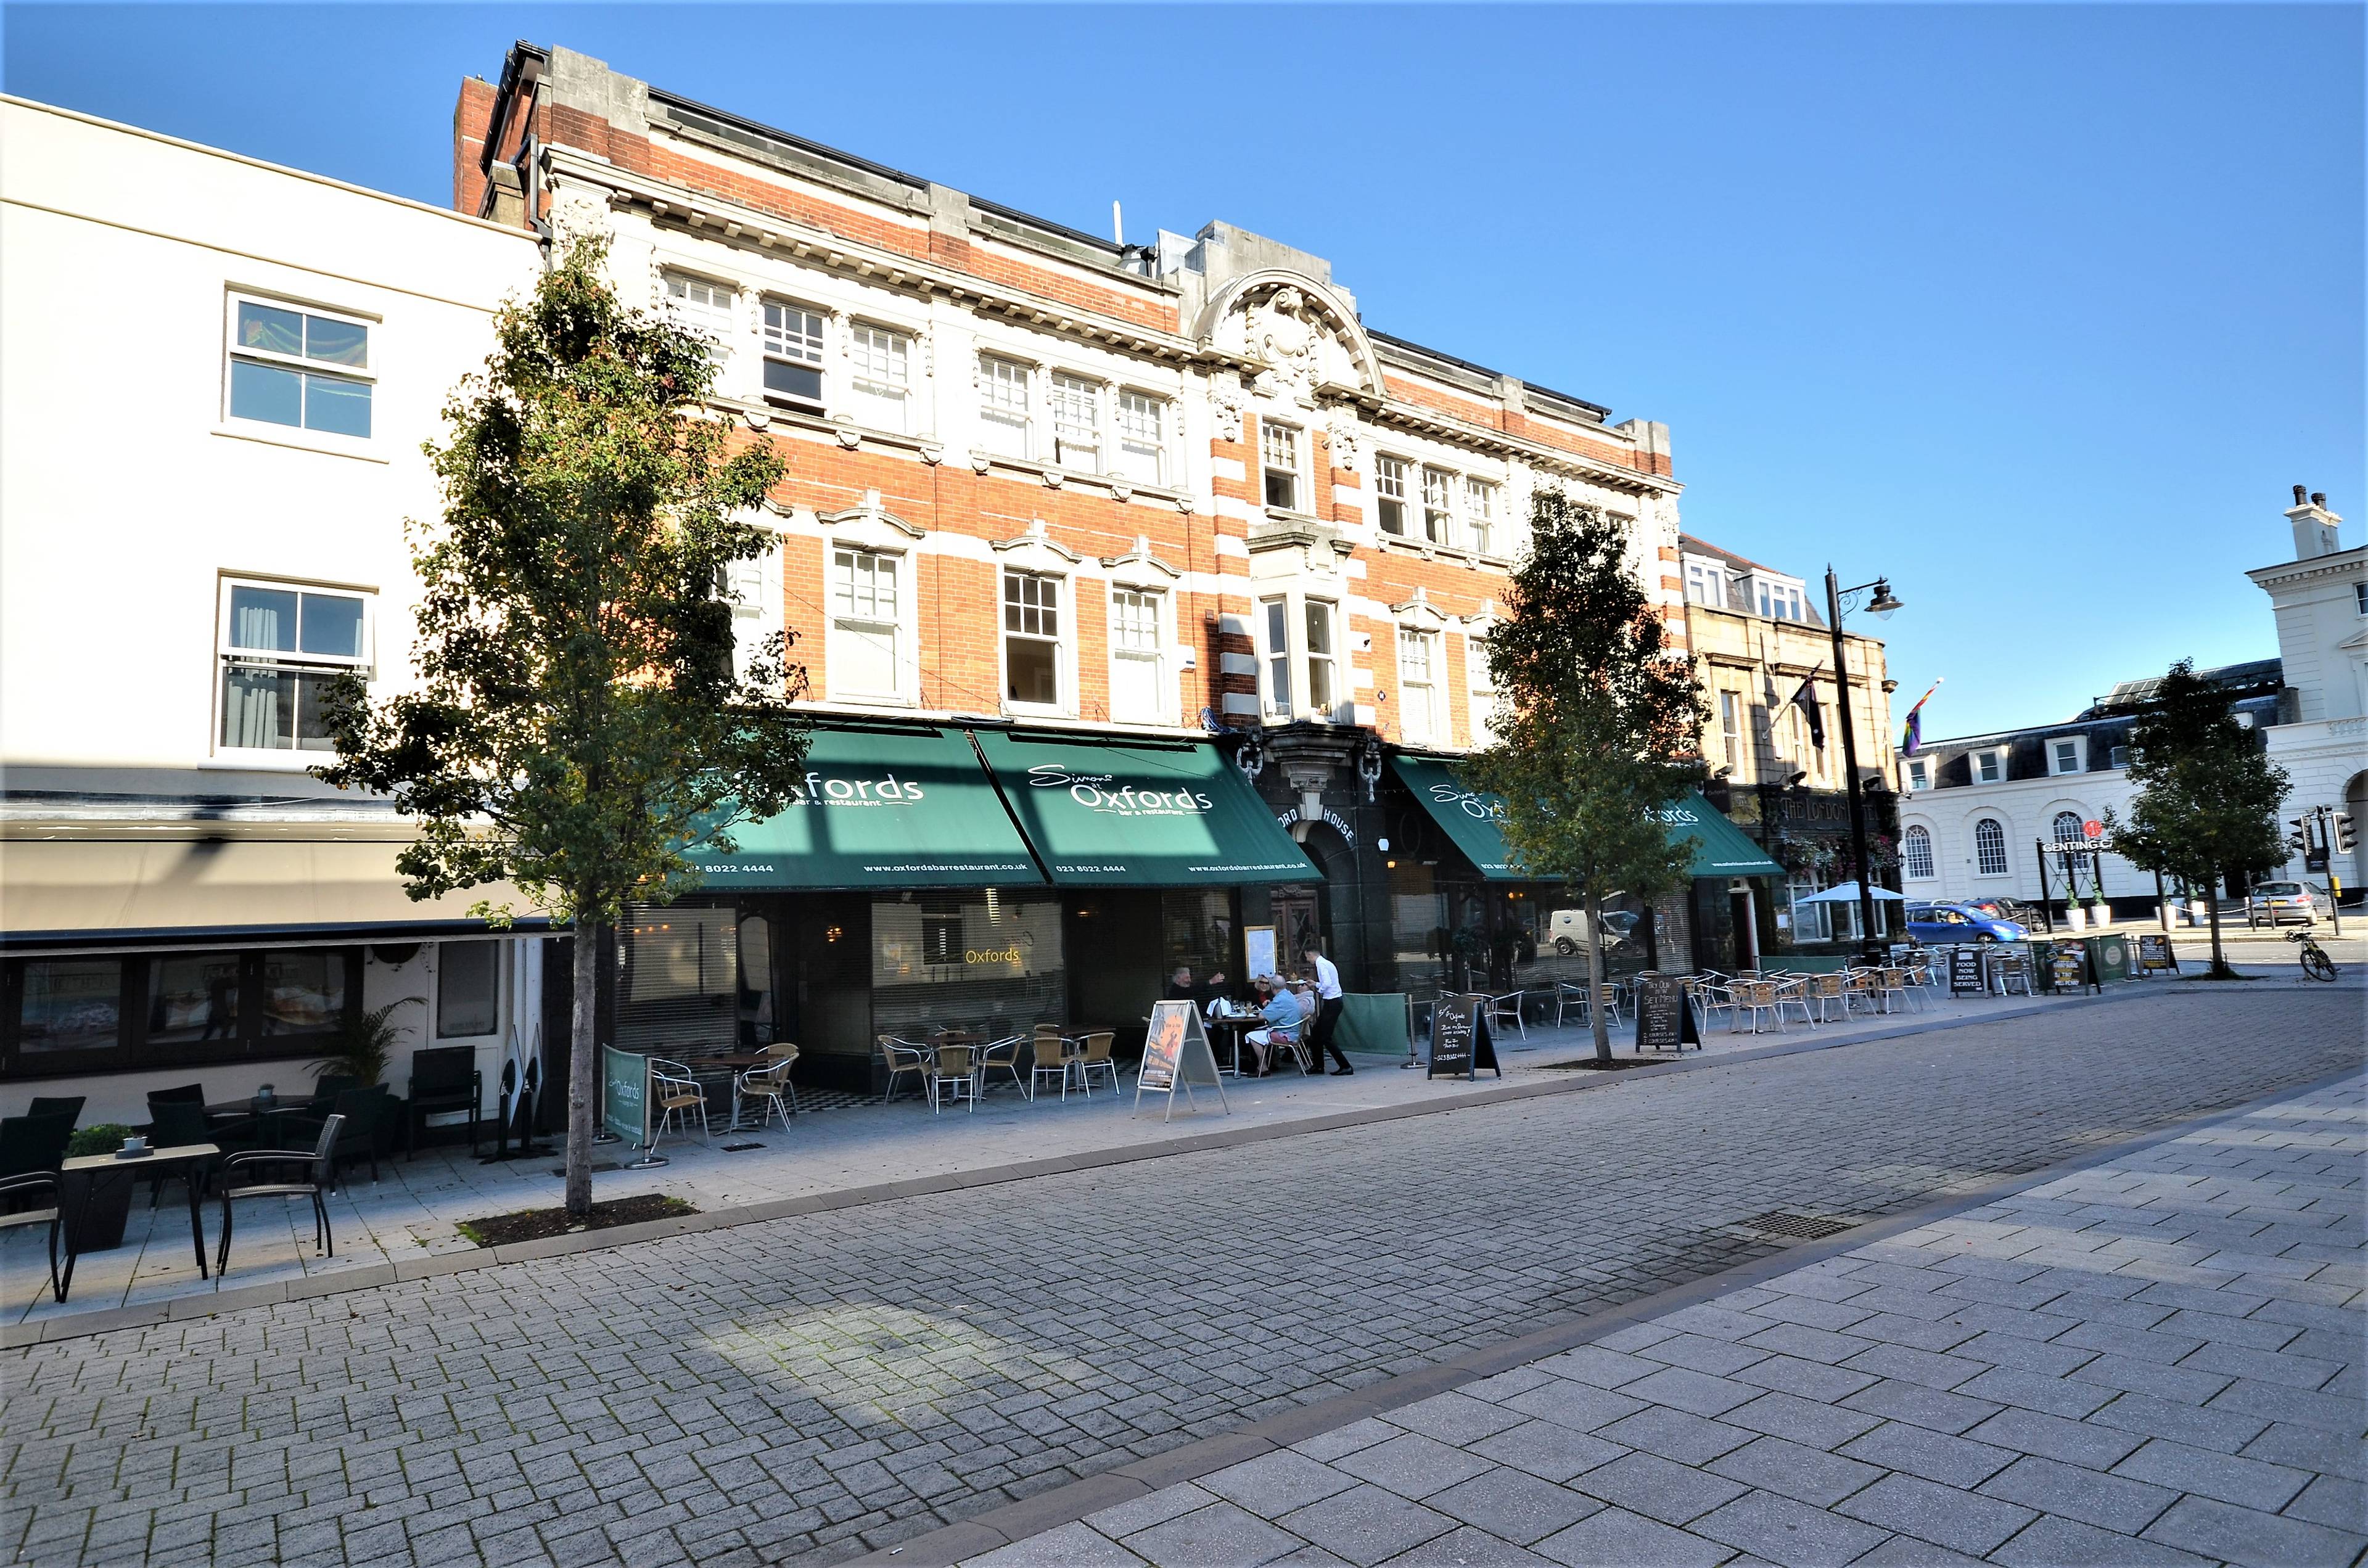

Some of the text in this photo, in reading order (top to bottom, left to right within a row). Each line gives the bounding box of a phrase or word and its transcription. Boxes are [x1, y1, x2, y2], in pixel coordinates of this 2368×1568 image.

[791, 772, 924, 800] fords
[824, 798, 882, 807] restaurant
[1071, 784, 1213, 810] Oxfords
[1643, 805, 1699, 822] ords
[1780, 797, 1805, 819] THE
[1806, 798, 1846, 821] LONDON
[1846, 800, 1880, 823] TEL
[1323, 809, 1354, 842] HOUSE
[2043, 839, 2098, 852] GENTING
[705, 864, 738, 872] 8022
[742, 864, 774, 872] 4444
[863, 863, 1028, 872] www.oxfordsbarrestaurant.co.uk
[1188, 862, 1307, 872] www.oxfordsbarrestaurant.co.uk
[966, 948, 1019, 963] Oxfords
[1644, 994, 1679, 1005] SET MENU
[616, 1080, 639, 1099] Oxfords
